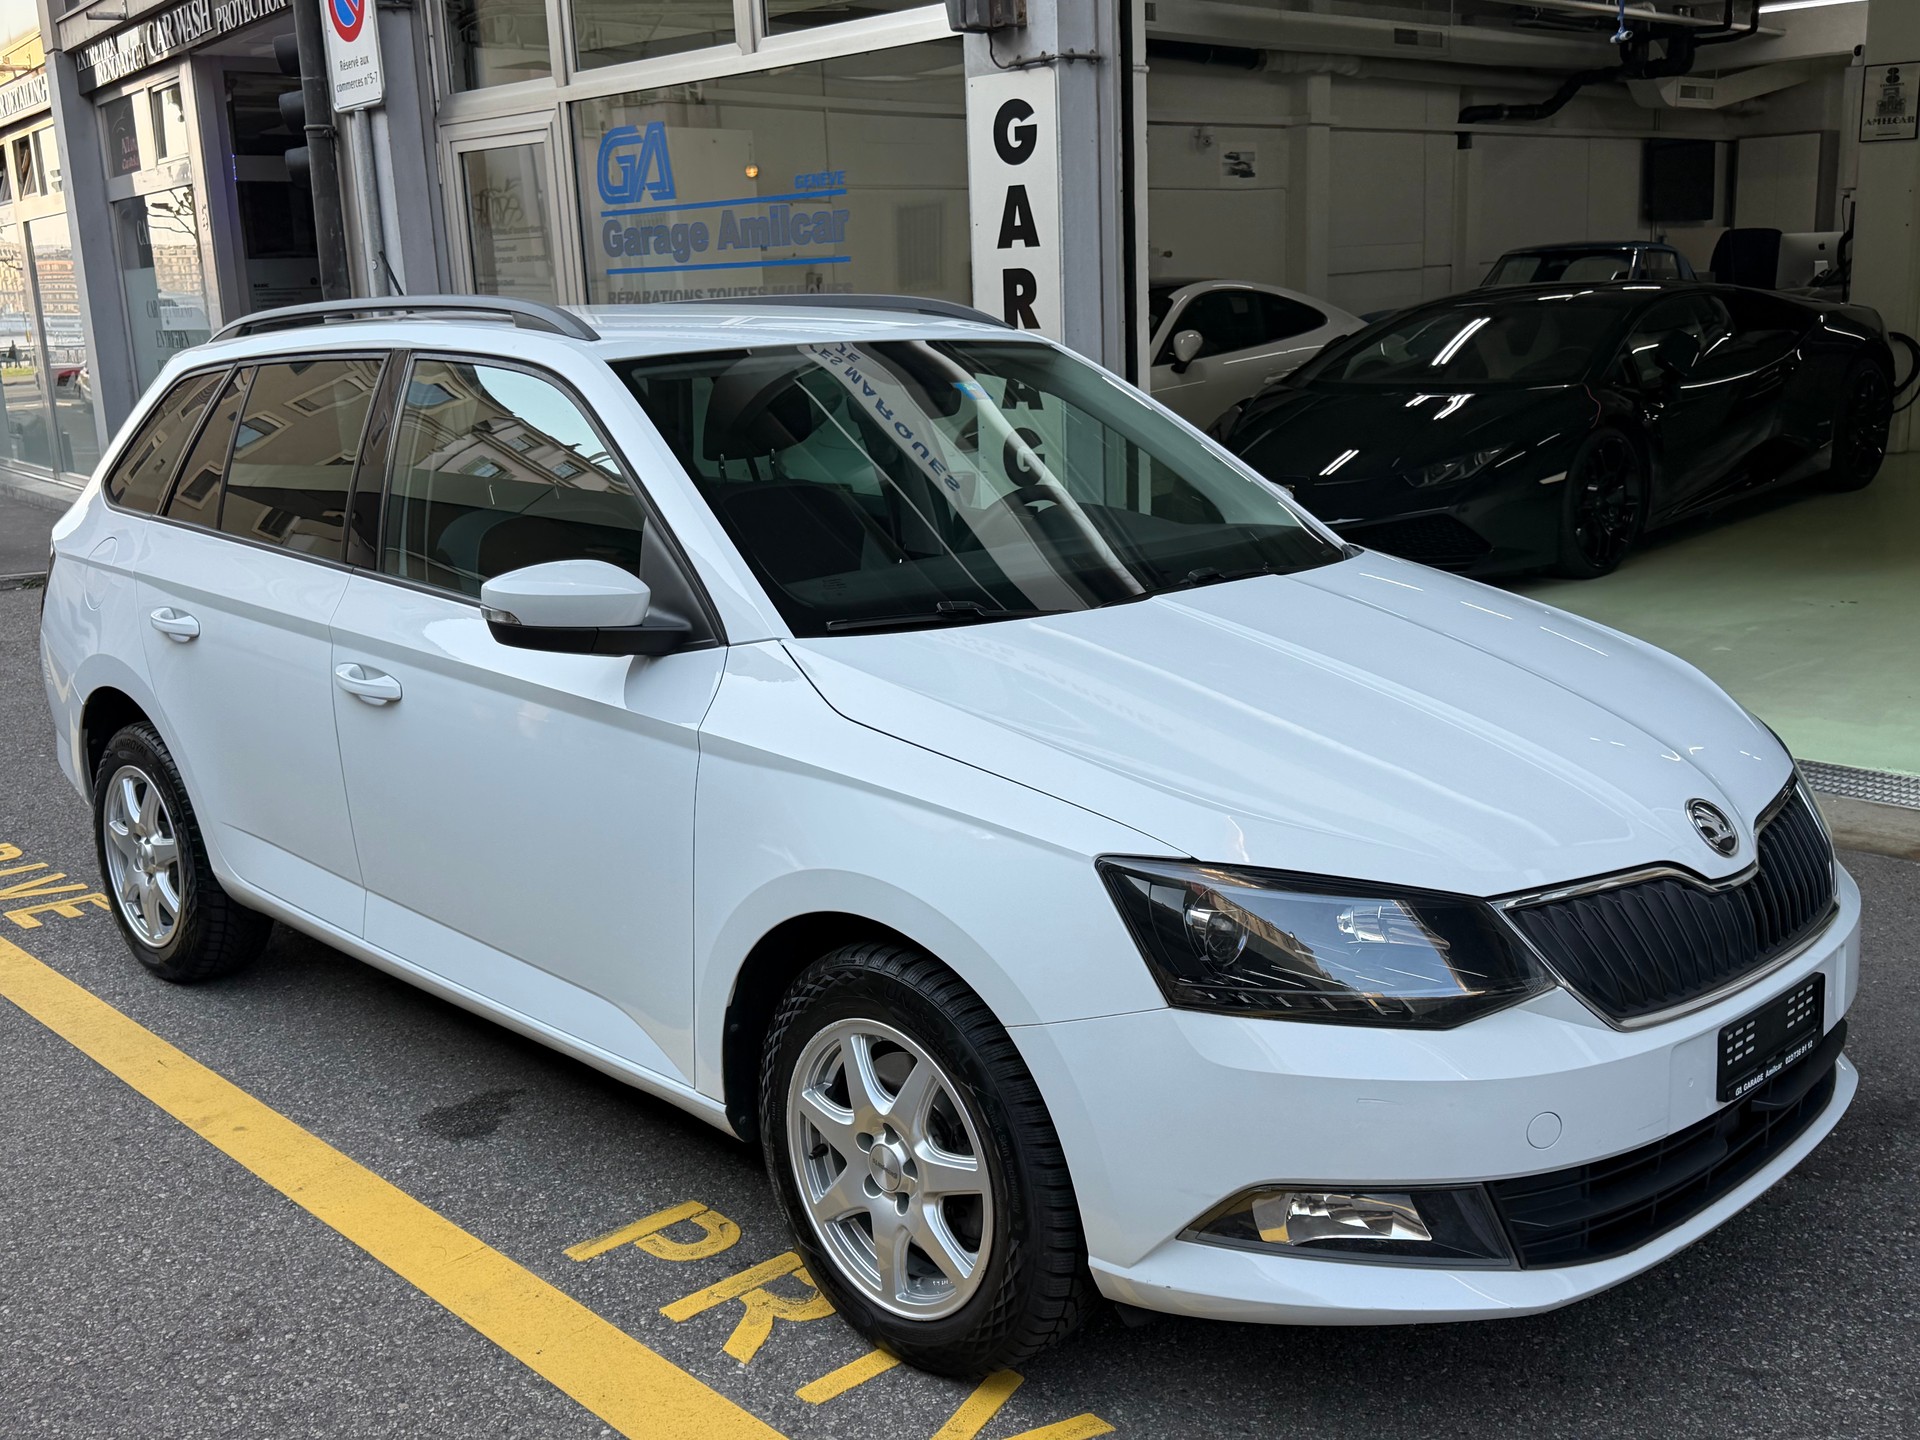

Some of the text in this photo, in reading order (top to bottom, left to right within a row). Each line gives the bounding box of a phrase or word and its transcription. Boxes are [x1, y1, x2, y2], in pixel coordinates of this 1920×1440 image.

[147, 13, 175, 57] CAR
[173, 0, 214, 44] WASH
[339, 56, 369, 71] Réservé aux
[336, 78, 363, 92] commerces
[596, 121, 677, 204] GA
[602, 204, 849, 263] Garage Amilcar
[1743, 1073, 1764, 1091] GARAGE
